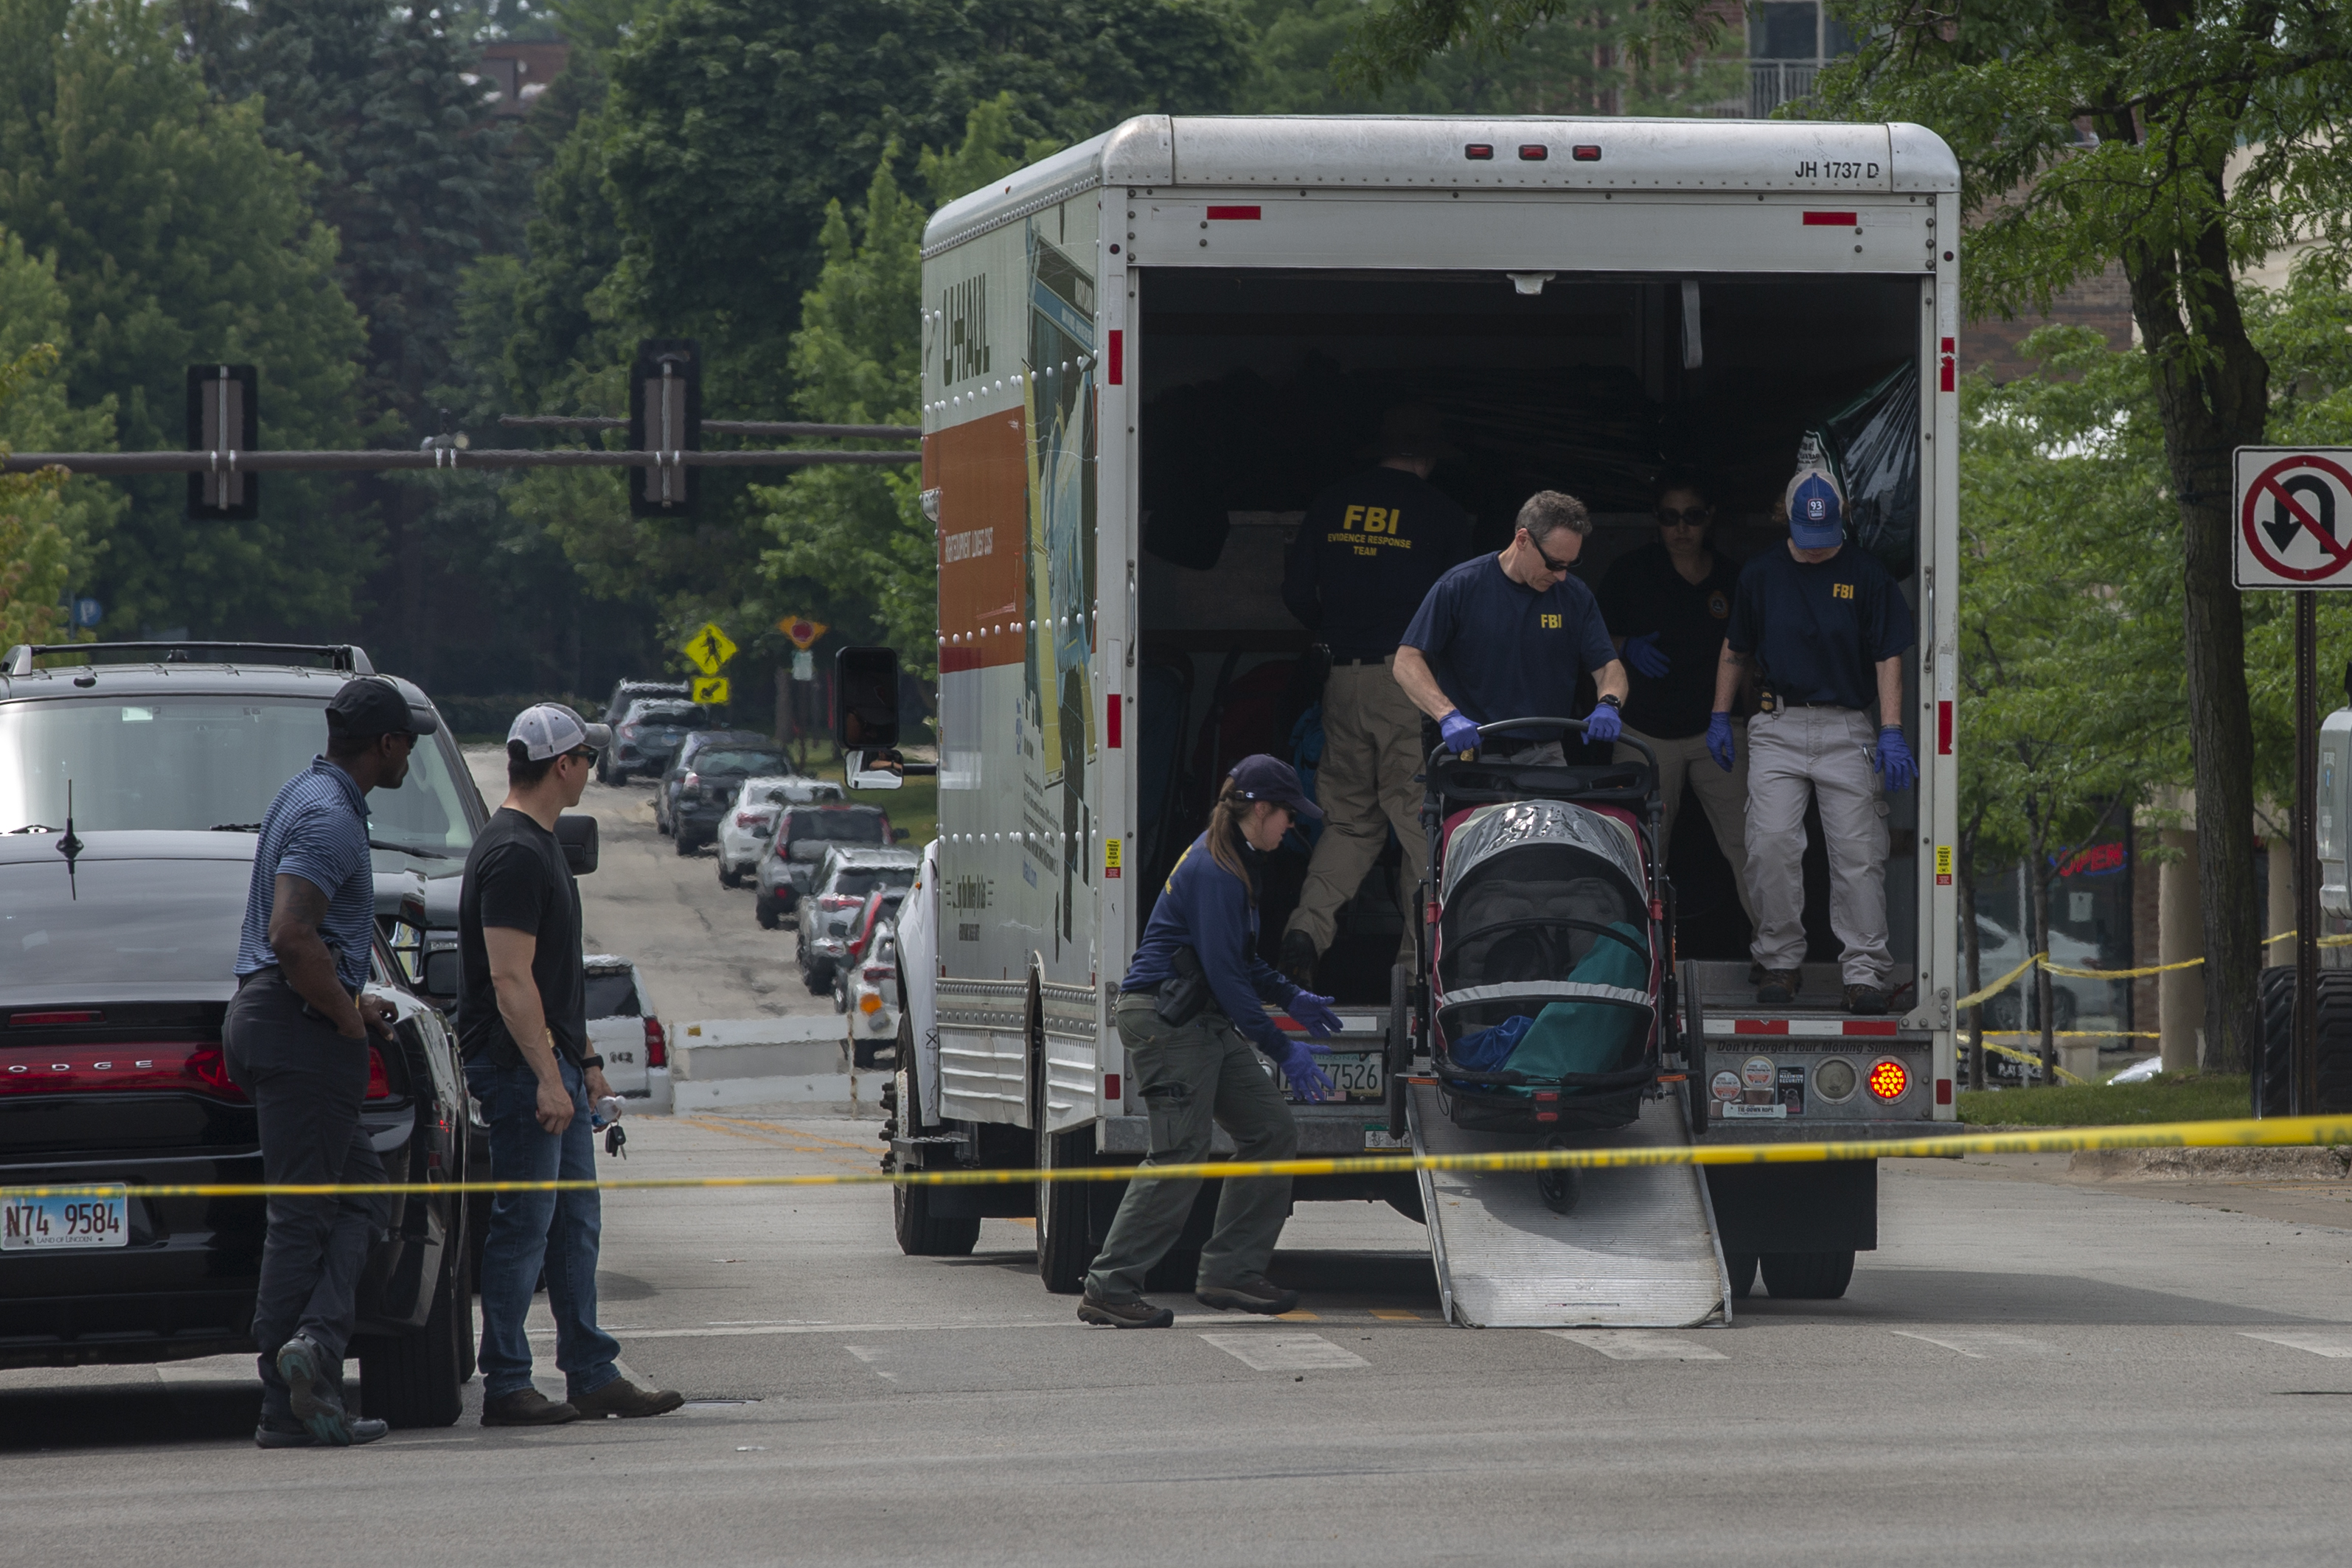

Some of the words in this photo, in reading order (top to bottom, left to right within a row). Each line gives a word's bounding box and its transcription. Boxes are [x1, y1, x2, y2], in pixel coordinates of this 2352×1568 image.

[1795, 161, 1817, 178] JH
[1823, 162, 1862, 179] 1737
[1867, 162, 1880, 179] D
[943, 272, 991, 387] U-HAUL
[1810, 501, 1823, 510] 93
[1343, 504, 1401, 534] FBI
[1327, 533, 1366, 544] EVIDENCE
[1367, 534, 1412, 549] RESPONSE
[1353, 546, 1377, 557] TEAM
[1832, 583, 1854, 599] FBI
[1540, 613, 1562, 629] FBI
[2059, 842, 2123, 877] OPEN
[1716, 1040, 1750, 1052] Don't
[1751, 1040, 1790, 1054] Forget
[1792, 1041, 1818, 1053] Your
[1820, 1041, 1864, 1054] Moving
[1866, 1042, 1921, 1055] Supplies!
[1312, 1053, 1360, 1062] RIZONA
[1284, 1063, 1379, 1090] 77526
[6, 1204, 49, 1238] N74
[64, 1202, 119, 1235] 9584
